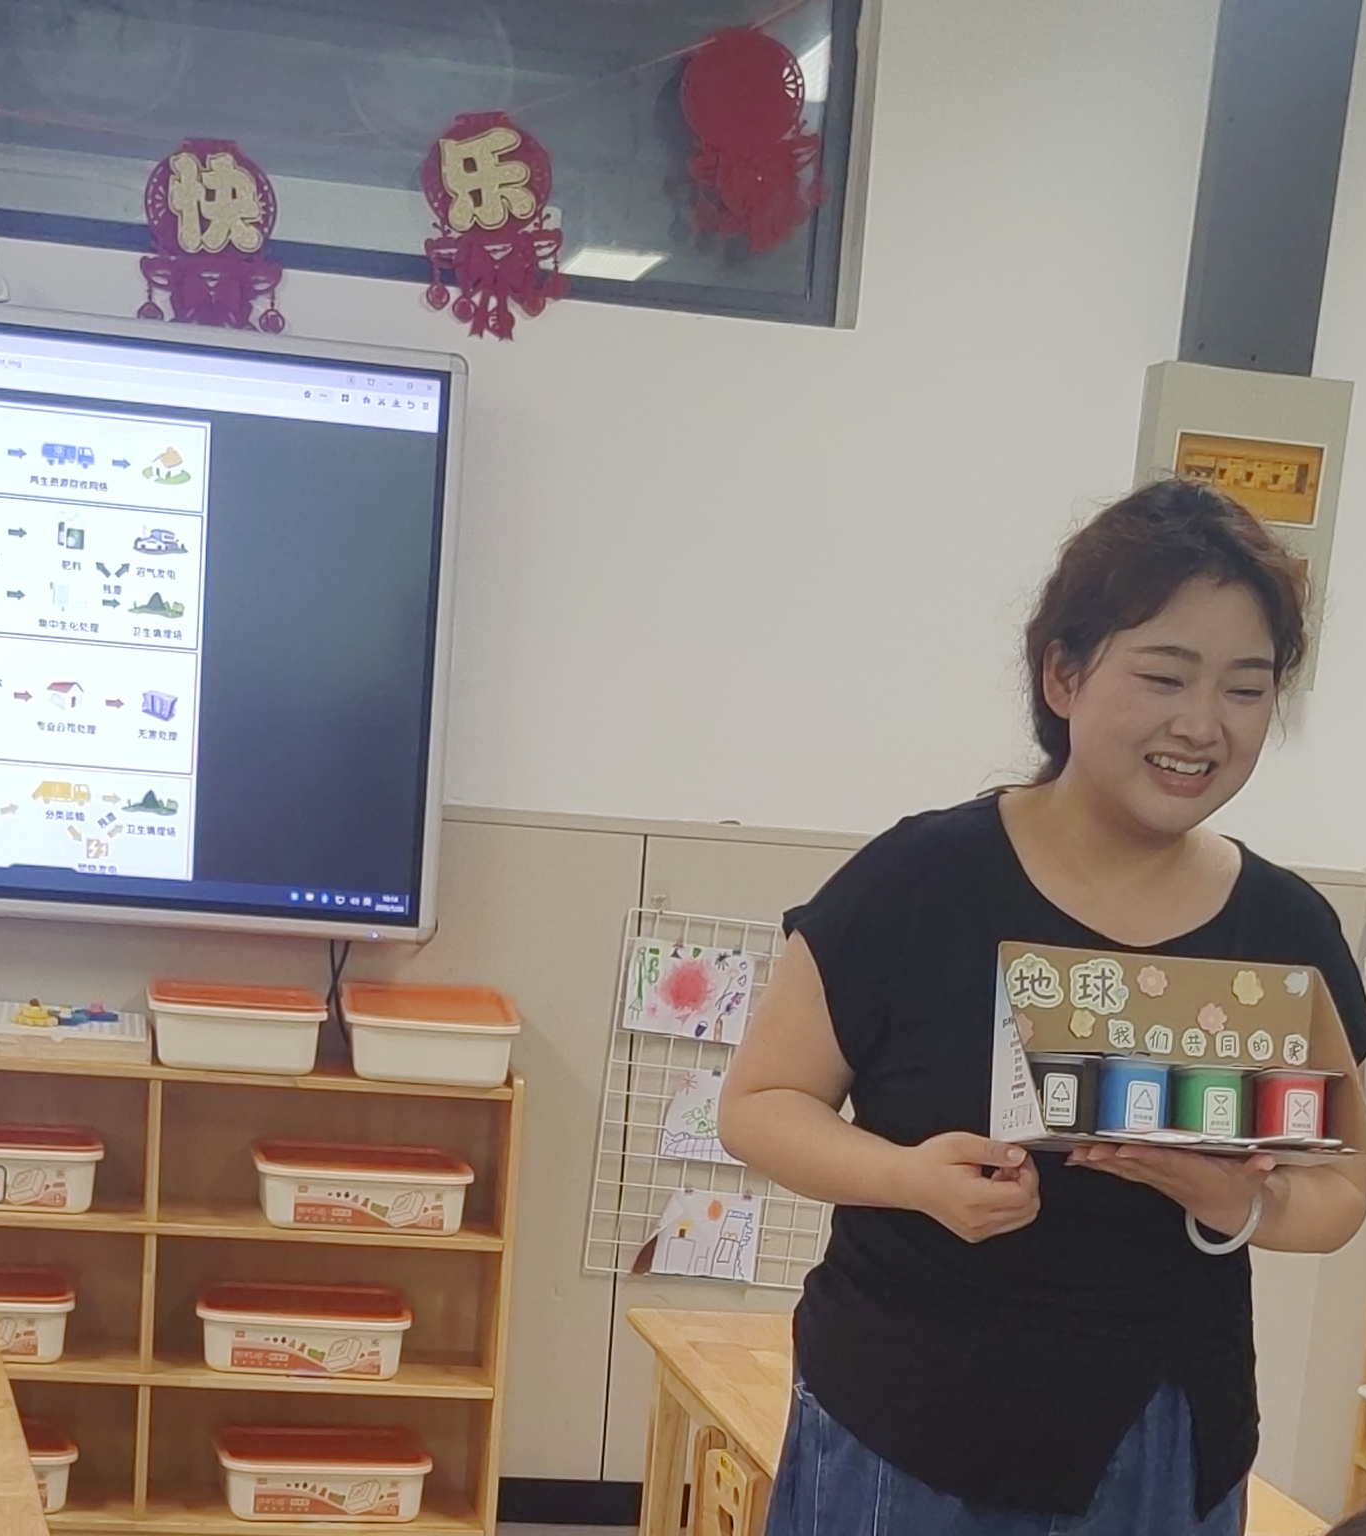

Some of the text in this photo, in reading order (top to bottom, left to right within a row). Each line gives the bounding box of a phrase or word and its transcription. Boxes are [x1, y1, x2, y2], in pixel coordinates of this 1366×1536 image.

[30, 475, 108, 492] 再生资源回收网络
[62, 560, 82, 571] 肥料
[1013, 964, 1119, 1010] 地球
[1112, 1025, 1306, 1062] 我们共同的家
